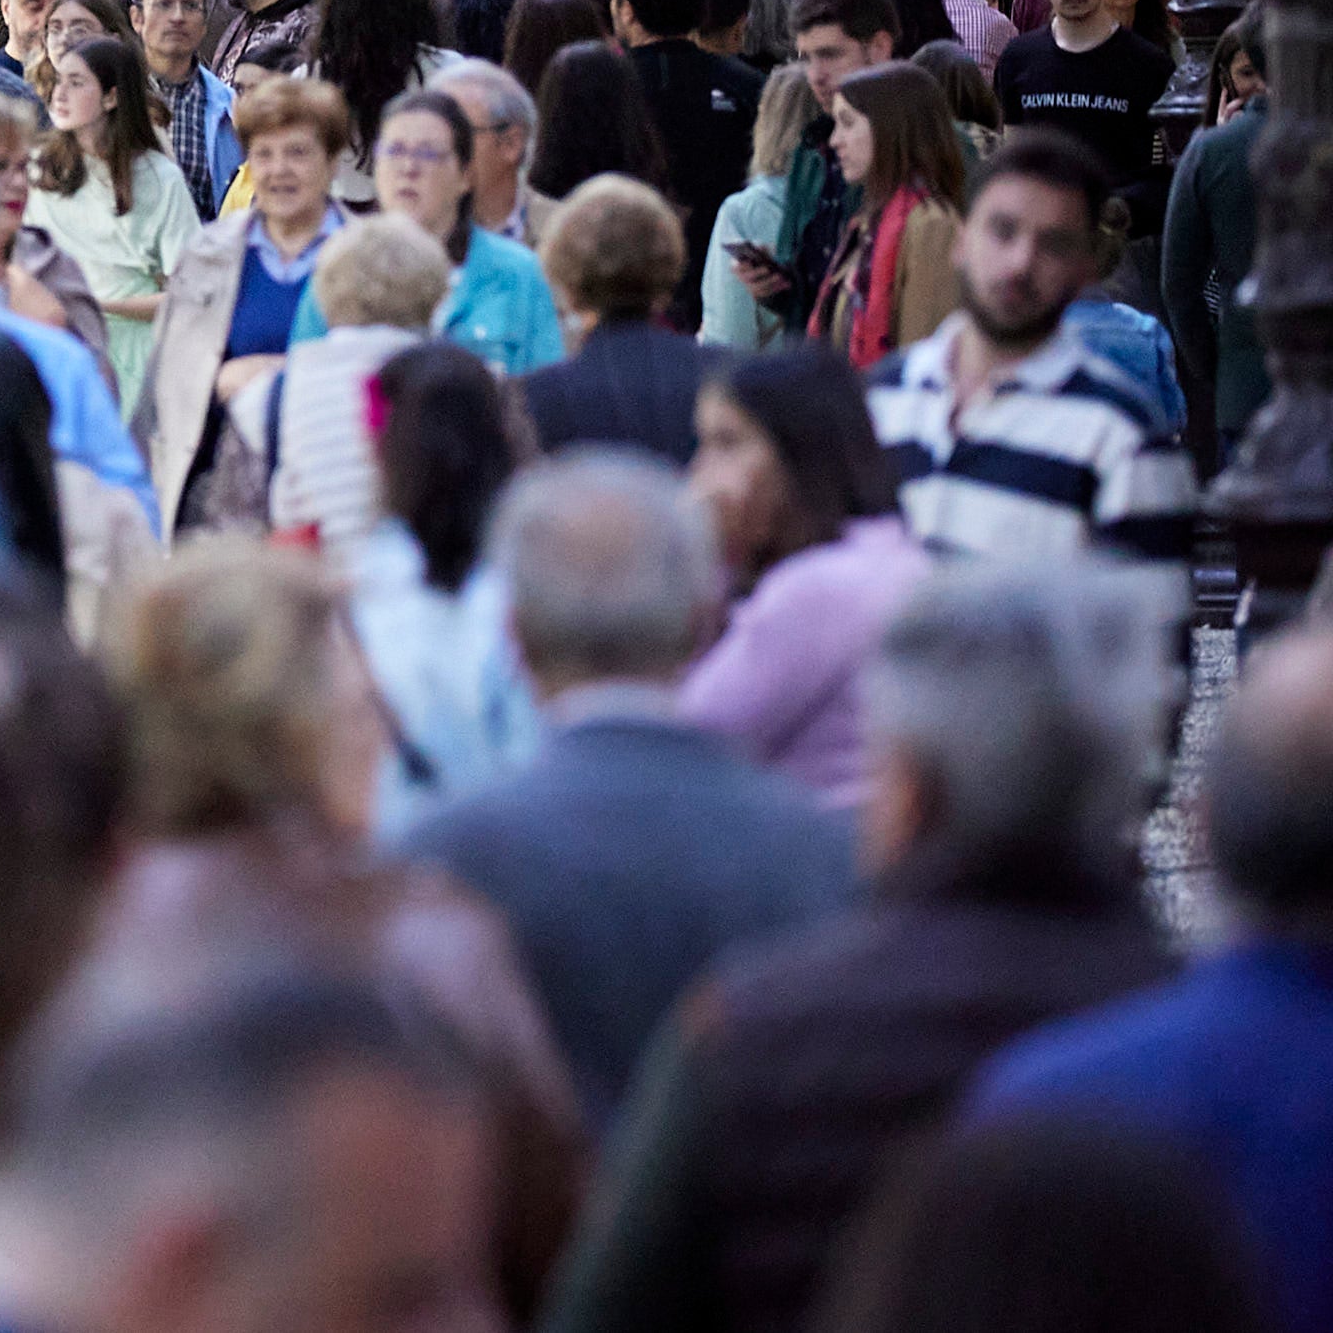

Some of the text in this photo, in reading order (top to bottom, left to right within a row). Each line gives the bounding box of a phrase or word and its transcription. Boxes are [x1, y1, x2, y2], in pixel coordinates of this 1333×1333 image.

[1021, 92, 1129, 112] CALVIN KLEIN JEANS
